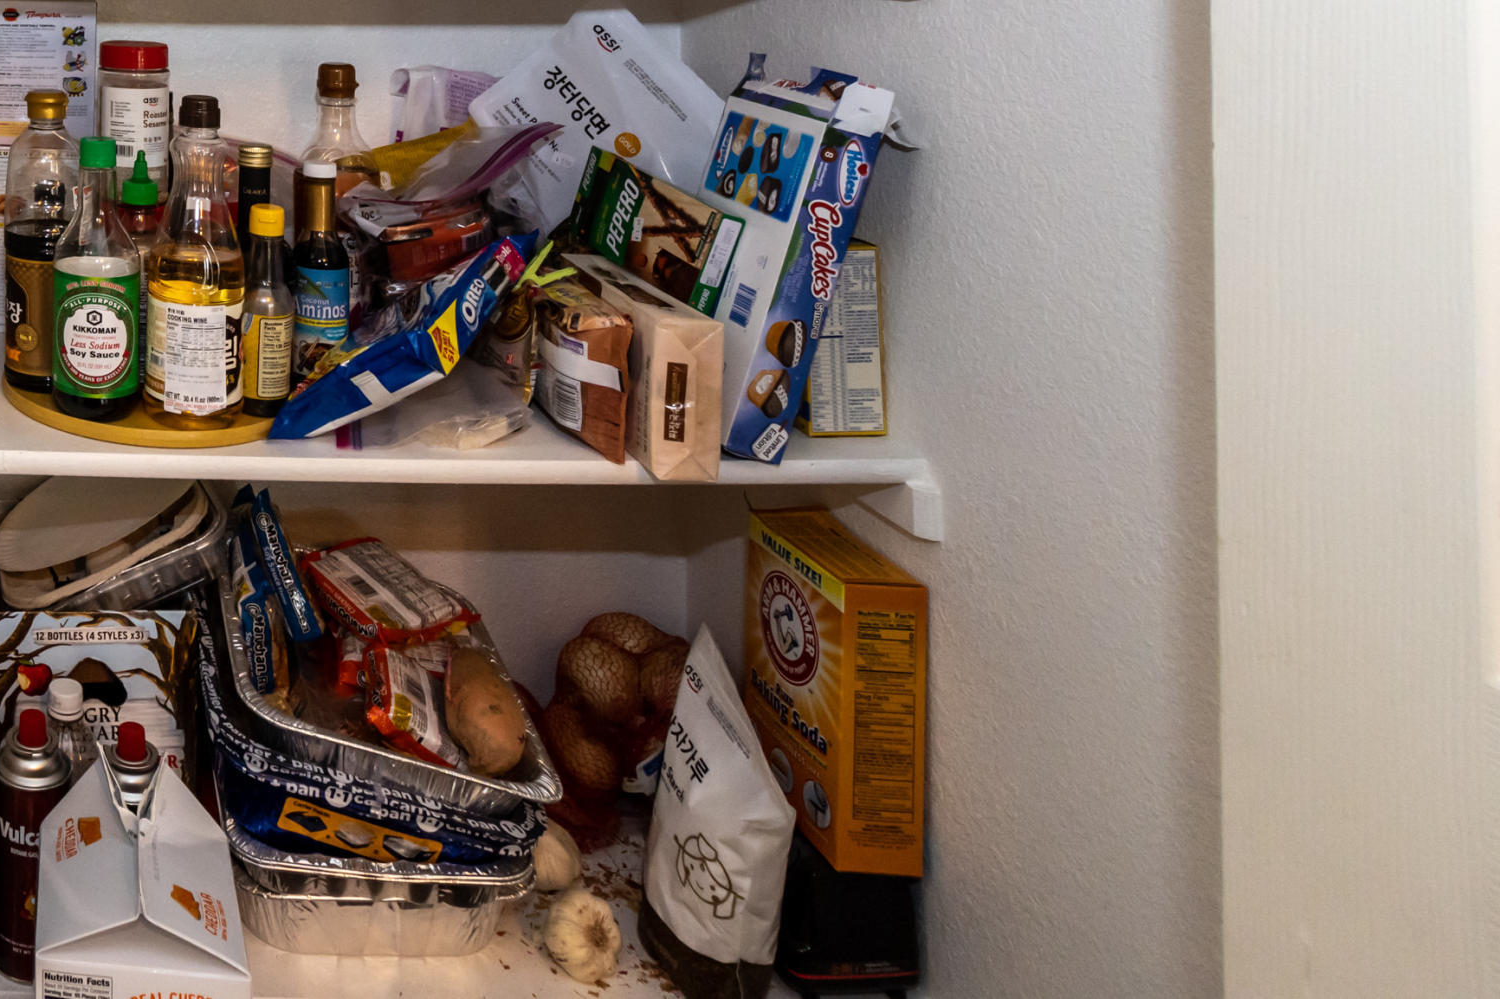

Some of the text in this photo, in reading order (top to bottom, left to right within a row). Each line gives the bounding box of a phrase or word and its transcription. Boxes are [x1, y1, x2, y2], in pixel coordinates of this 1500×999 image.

[593, 24, 620, 51] assi
[512, 97, 528, 116] Sweet
[582, 154, 597, 191] PEPERO
[844, 149, 862, 200] Hostess
[606, 178, 641, 256] PEPERO
[810, 201, 841, 299] CupCakes
[461, 278, 486, 326] OREO
[73, 325, 117, 334] KIKKOMAN
[167, 314, 192, 323] COOKING
[70, 339, 120, 349] Less Sodium
[70, 348, 120, 358] Soy Sauce
[754, 428, 776, 450] Edition
[763, 432, 783, 459] Limited
[761, 529, 822, 588] VALUE SIZE!
[761, 585, 773, 617] ARM
[781, 578, 816, 659] HAMMER
[35, 630, 145, 643] 12 BOTTLES (4 STYLES x3)
[253, 615, 268, 676] Maruchan
[685, 664, 704, 691] assi
[750, 667, 828, 756] Baking Soda
[291, 759, 324, 774] pan
[285, 783, 320, 798] pan
[666, 766, 686, 803] Starch
[64, 817, 78, 860] CHEDDAR
[467, 818, 500, 833] pan
[200, 892, 218, 936] CHEDDAR
[44, 972, 111, 987] Nutrition Facts
